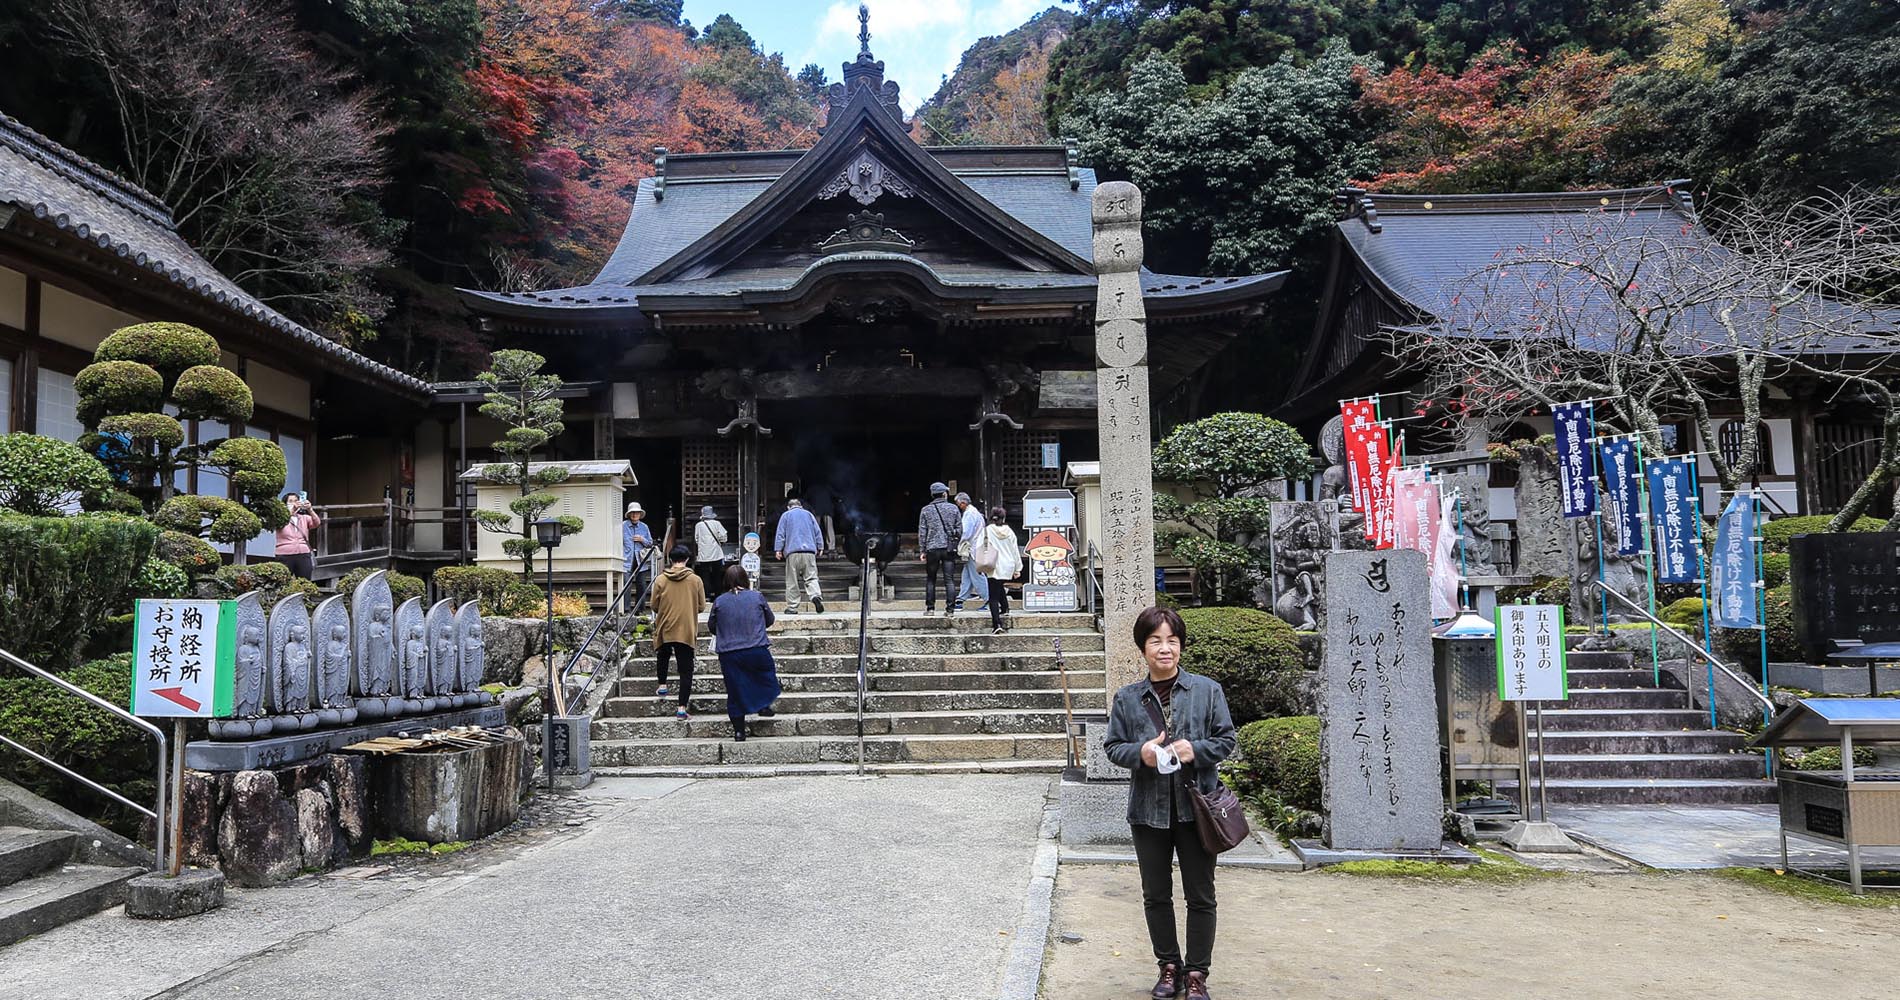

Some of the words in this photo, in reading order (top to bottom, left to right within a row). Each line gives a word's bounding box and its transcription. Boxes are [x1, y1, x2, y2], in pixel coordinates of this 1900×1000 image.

[1557, 410, 1582, 421] 奉納
[1565, 419, 1587, 512] 南無厄除け不動尊
[1652, 465, 1682, 475] 奉納
[1039, 506, 1060, 515] 本堂
[1662, 474, 1687, 578] 南無厄除け不動尊
[1726, 513, 1744, 622] 南無厄除け不動尊
[148, 606, 174, 684] お守授所
[179, 606, 203, 684] 納経所
[1511, 609, 1528, 697] 御朱印あります
[1535, 609, 1551, 669] 五大明王の
